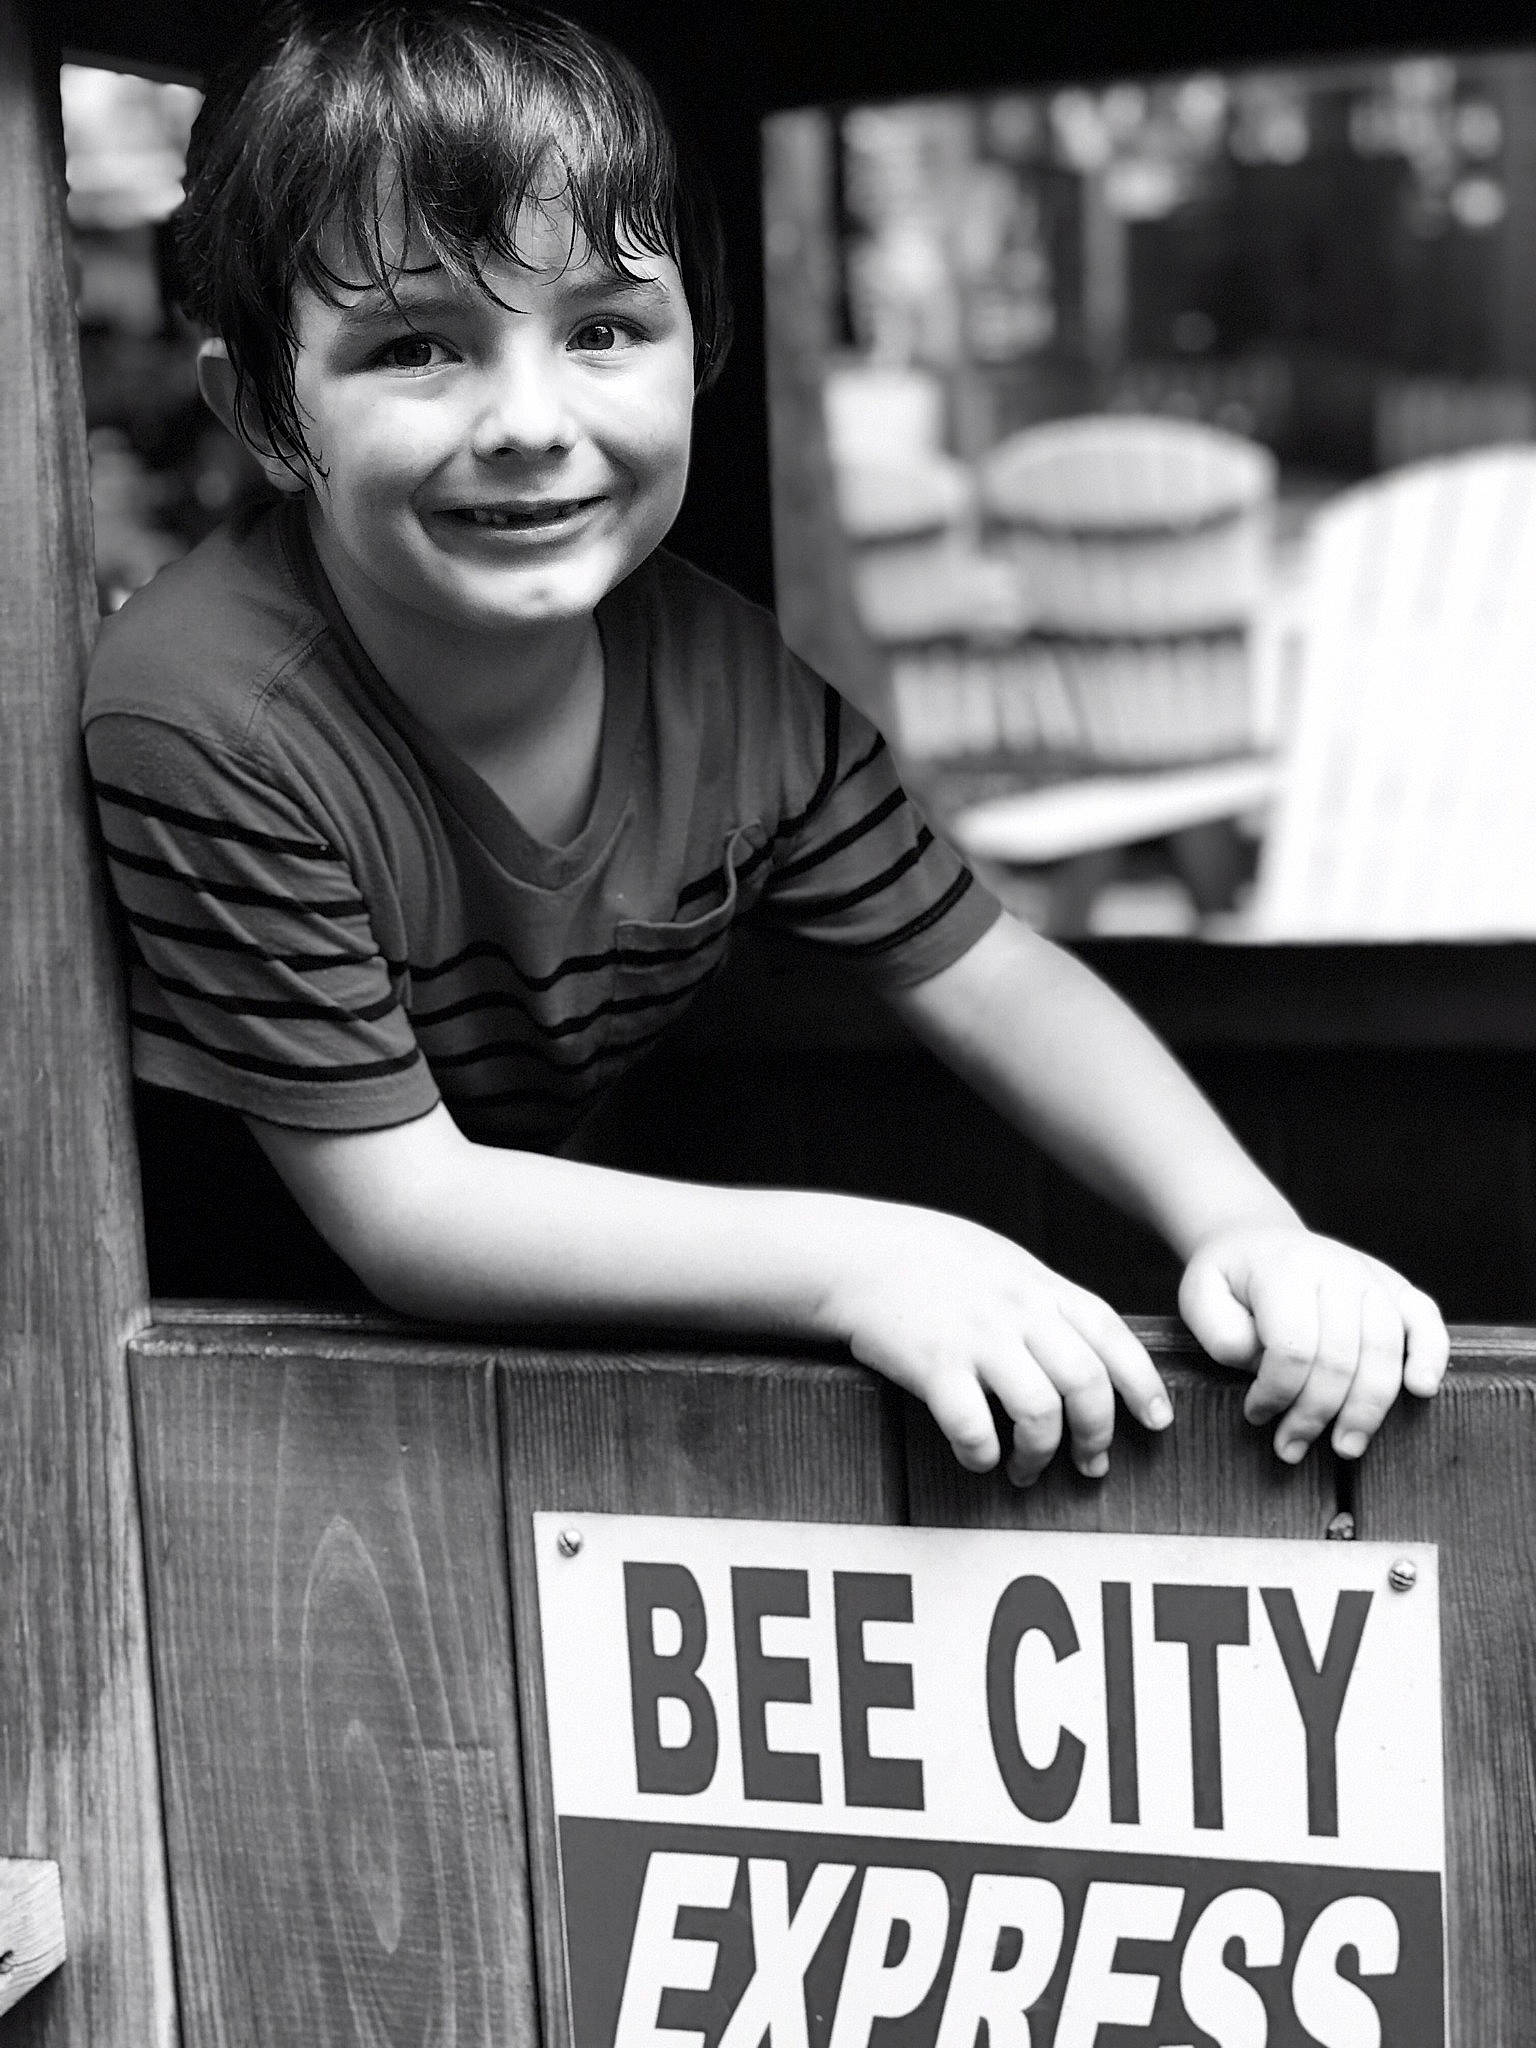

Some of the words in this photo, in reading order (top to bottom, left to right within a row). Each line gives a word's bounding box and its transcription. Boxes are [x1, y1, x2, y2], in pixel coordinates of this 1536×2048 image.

[623, 1561, 926, 1812] BEE
[986, 1575, 1375, 1838] CITY
[613, 1851, 1400, 2048] EXPRESS
